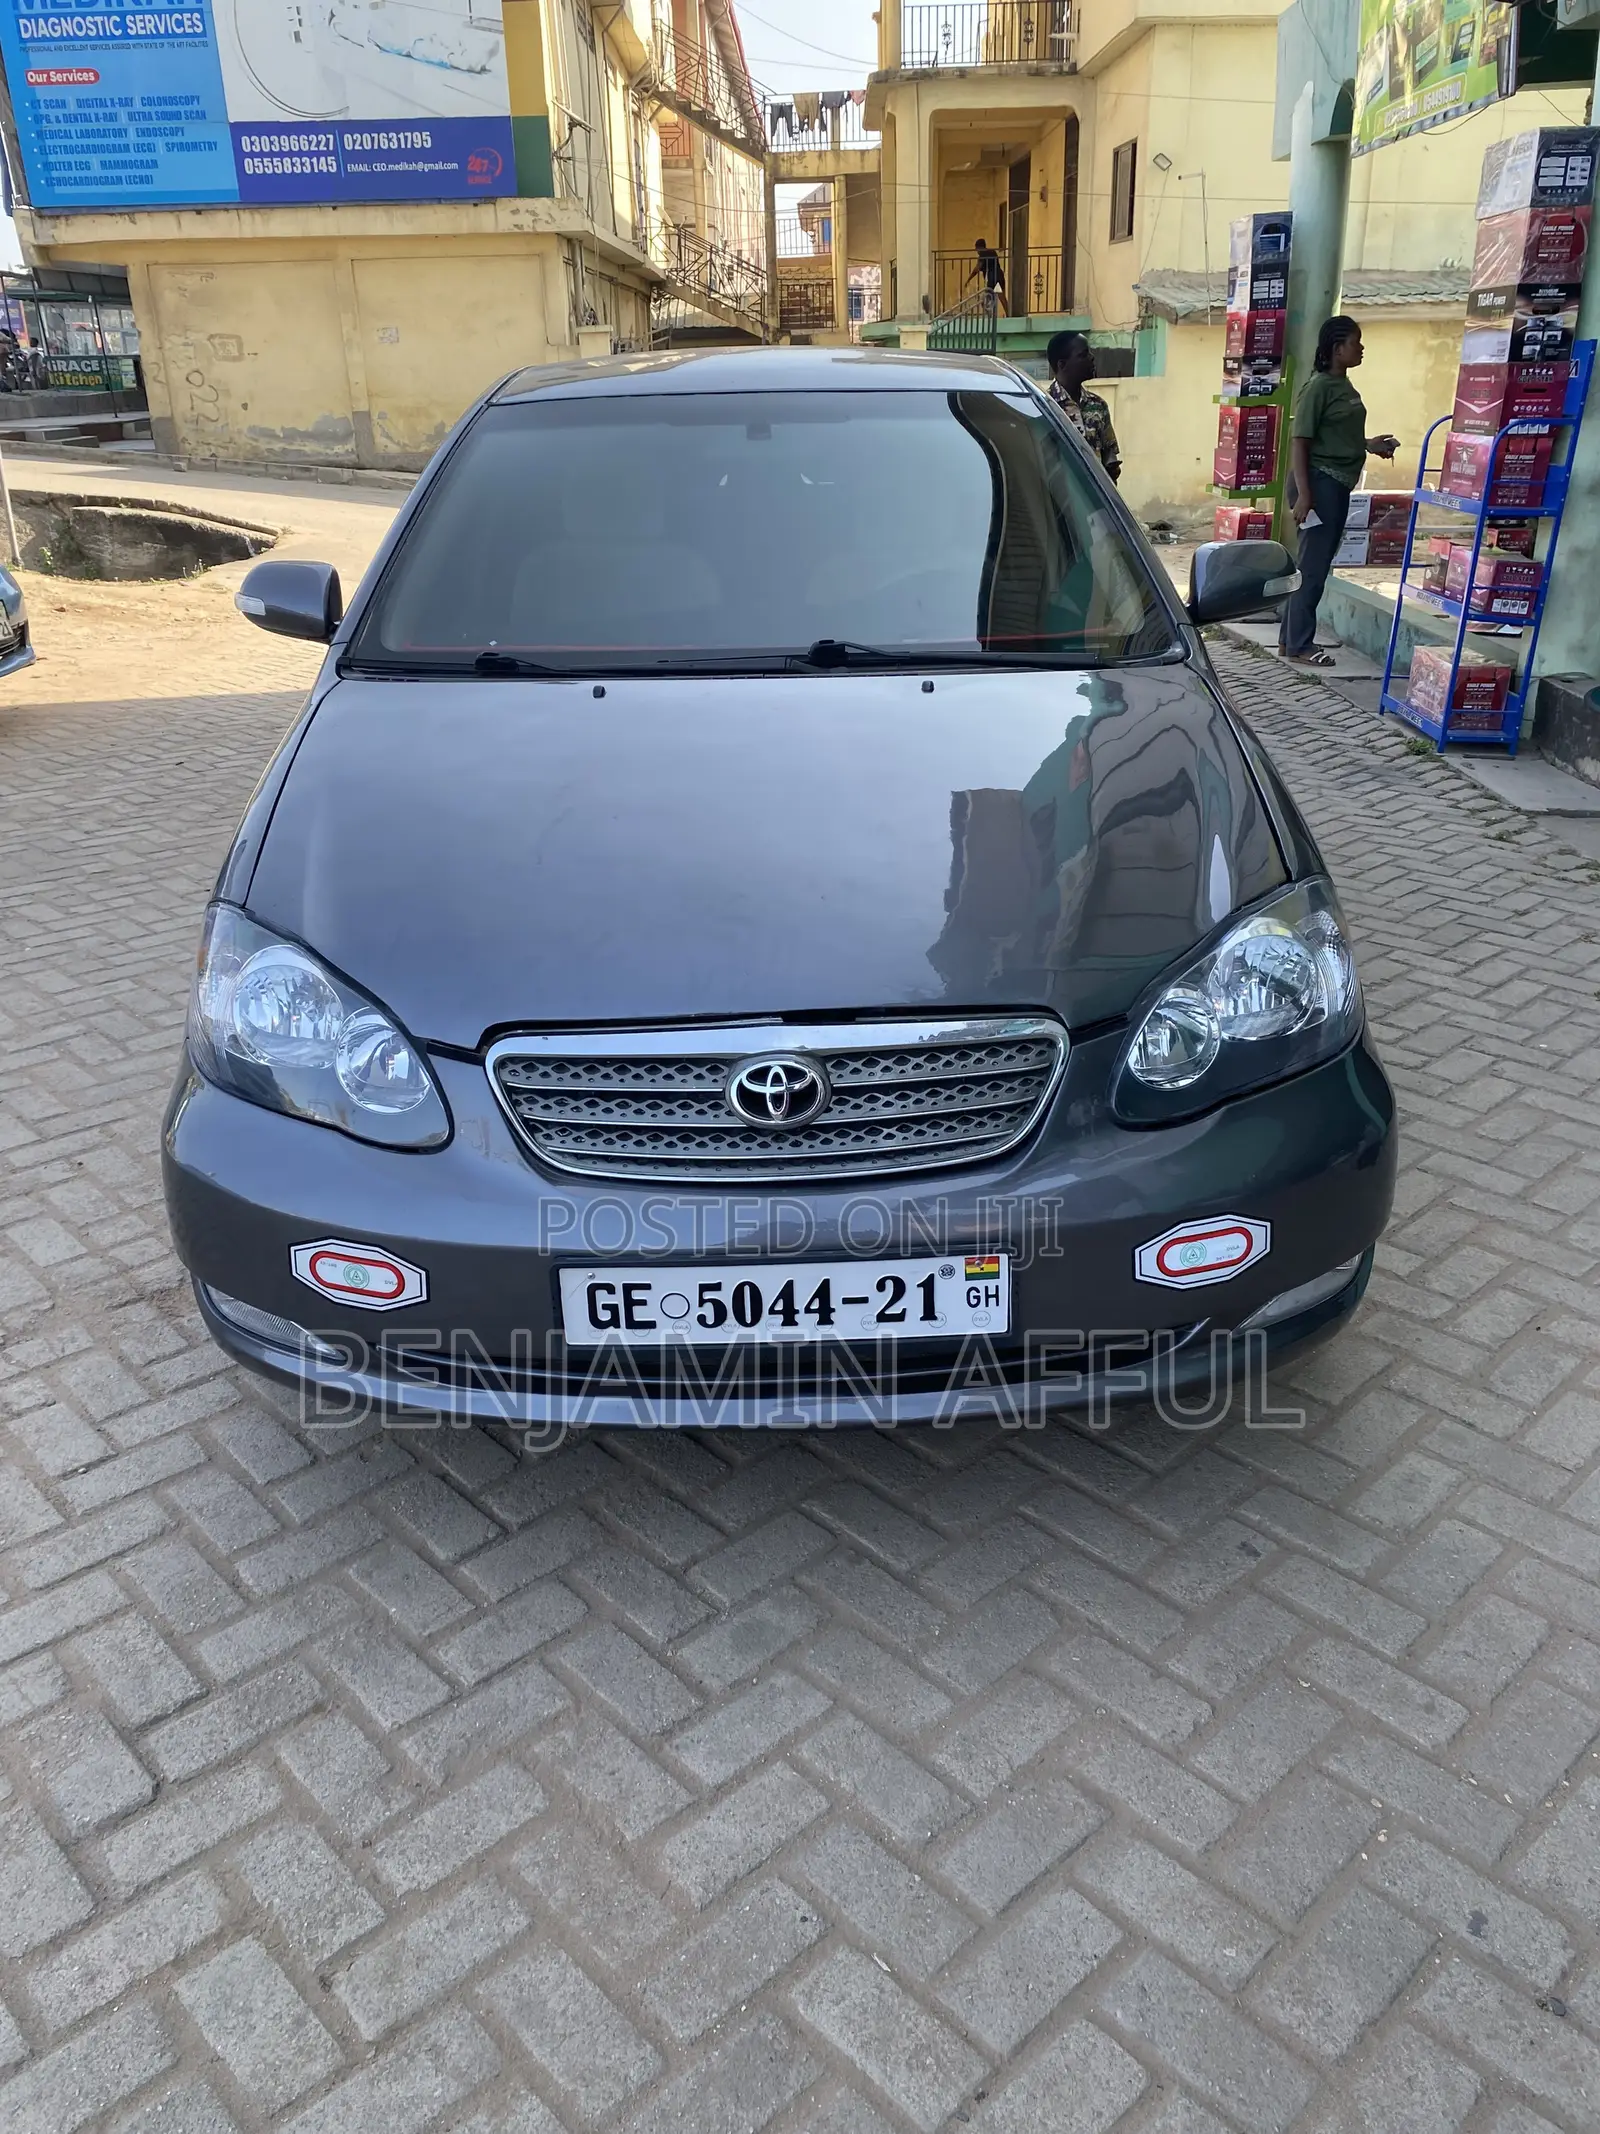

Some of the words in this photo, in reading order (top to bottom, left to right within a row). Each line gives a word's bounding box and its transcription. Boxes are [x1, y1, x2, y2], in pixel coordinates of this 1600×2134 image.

[18, 15, 122, 39] DIAGNOSTIC
[125, 12, 203, 35] SERVICES
[27, 71, 48, 83] Our
[49, 69, 95, 82] Services
[31, 99, 42, 110] CT
[43, 98, 67, 110] SCAN
[76, 98, 109, 109] DIGITAL
[109, 97, 134, 108] X-RAY
[140, 95, 200, 107] COLONOSCOPY
[62, 112, 93, 124] DENTAL
[93, 112, 118, 123] X-RAY
[127, 111, 153, 122] ULTRA
[154, 110, 182, 121] SOUND
[183, 110, 207, 121] SCAN
[36, 128, 73, 140] MEDICAL
[75, 127, 128, 139] LABORATORY
[135, 126, 185, 138] ENDOSCOPY
[39, 143, 131, 156] ELECTROCARDIOGRAM
[132, 142, 156, 154] (ECG)
[164, 141, 218, 153] SPIROMETRY
[241, 134, 334, 153] 0303966227
[343, 131, 432, 151] 0207631795
[42, 160, 73, 172] HOLTER
[74, 159, 91, 171] ECG
[99, 159, 159, 171] MAMMOGRAM
[244, 156, 337, 174] 0555833145
[347, 163, 372, 173] EMAIL:
[372, 161, 458, 172] CEO.medikah@gmail.com
[45, 176, 124, 188] ECHOCARDIOGRAM
[124, 174, 154, 186] (ECHO)
[586, 1281, 658, 1330] GE
[696, 1272, 938, 1329] 5044-21
[966, 1285, 1000, 1308] GH
